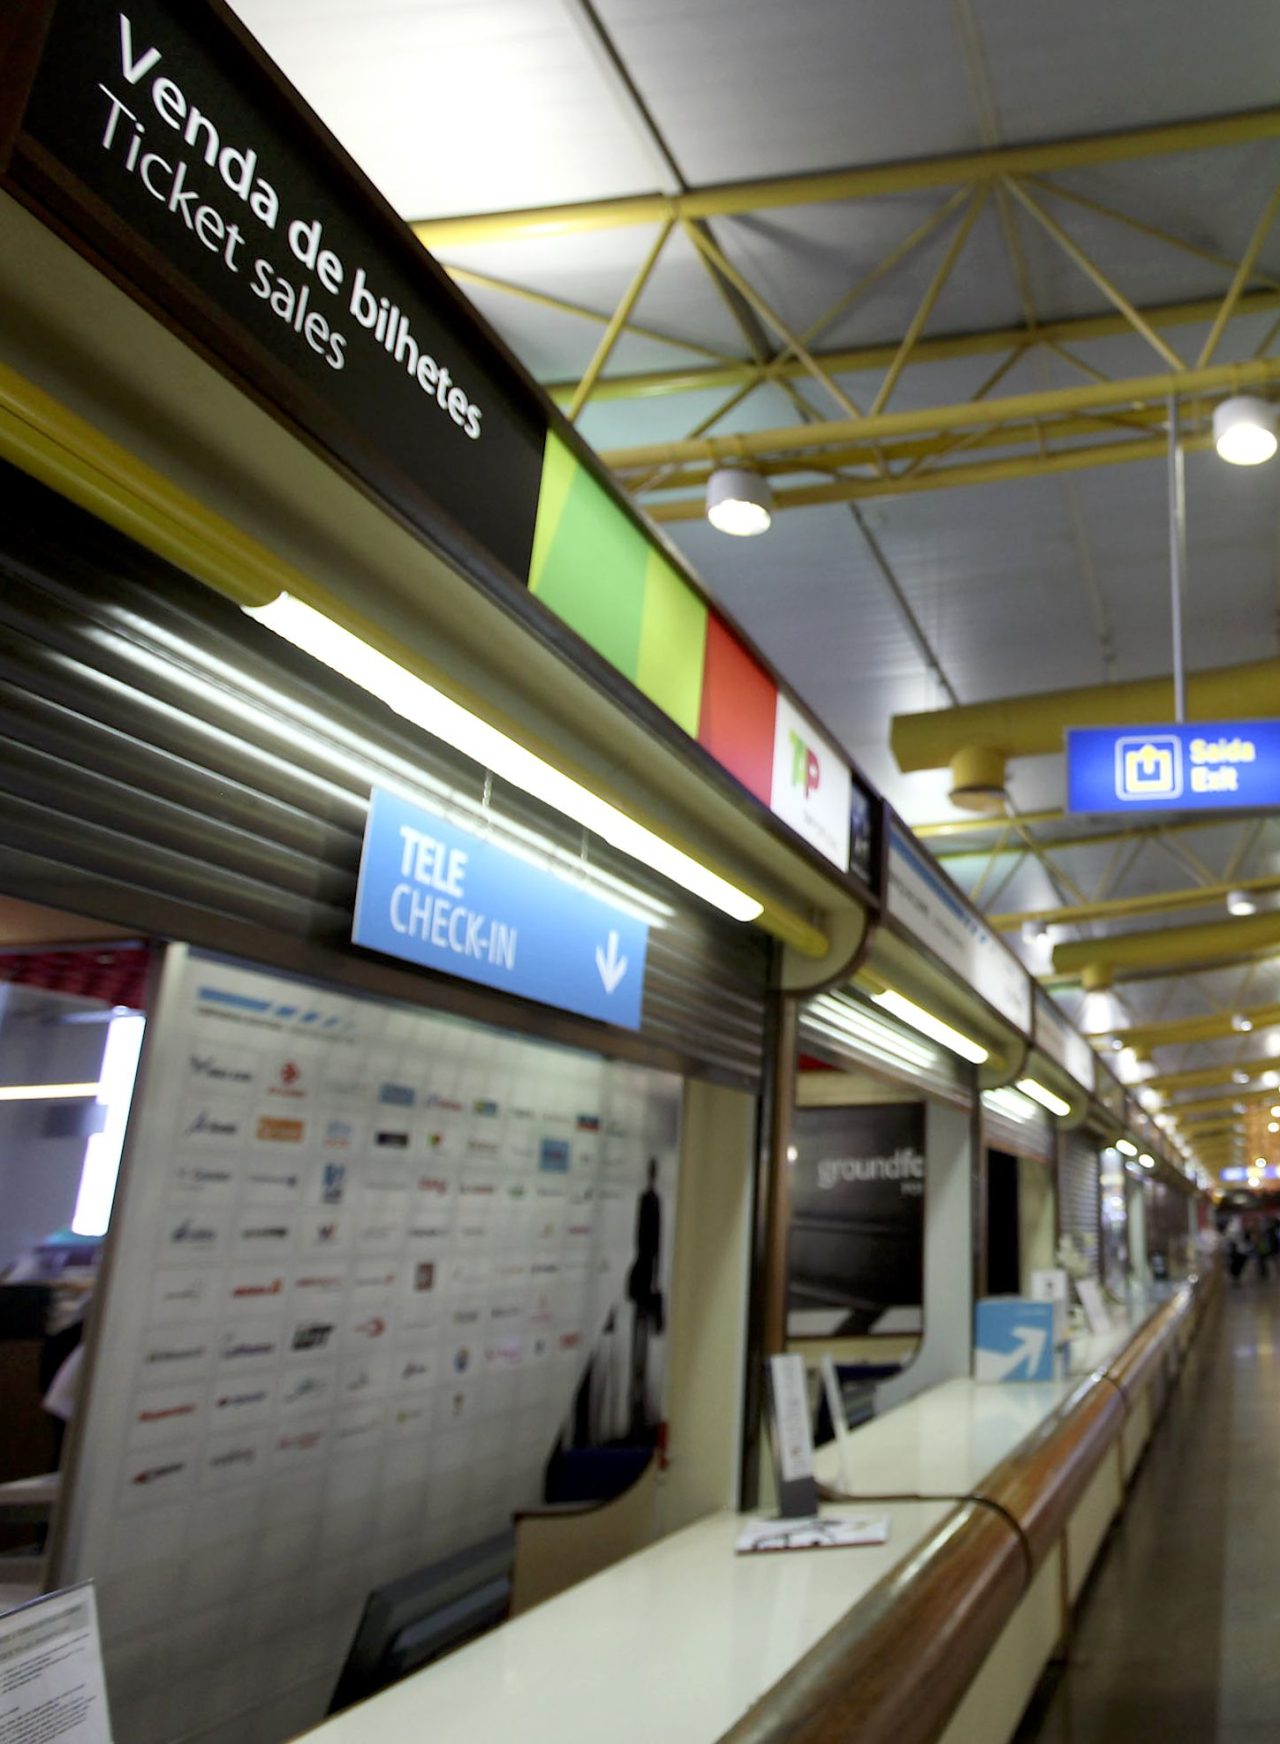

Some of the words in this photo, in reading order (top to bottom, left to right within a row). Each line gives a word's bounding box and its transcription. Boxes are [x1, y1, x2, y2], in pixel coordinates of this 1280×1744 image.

[98, 83, 245, 272] Ticket
[250, 259, 347, 370] sales
[120, 13, 279, 229] Venda
[288, 220, 343, 295] de
[349, 268, 482, 439] bilhetes
[1190, 766, 1239, 792] Exit
[399, 824, 469, 899] TELE
[389, 883, 518, 972] CHECK-IN
